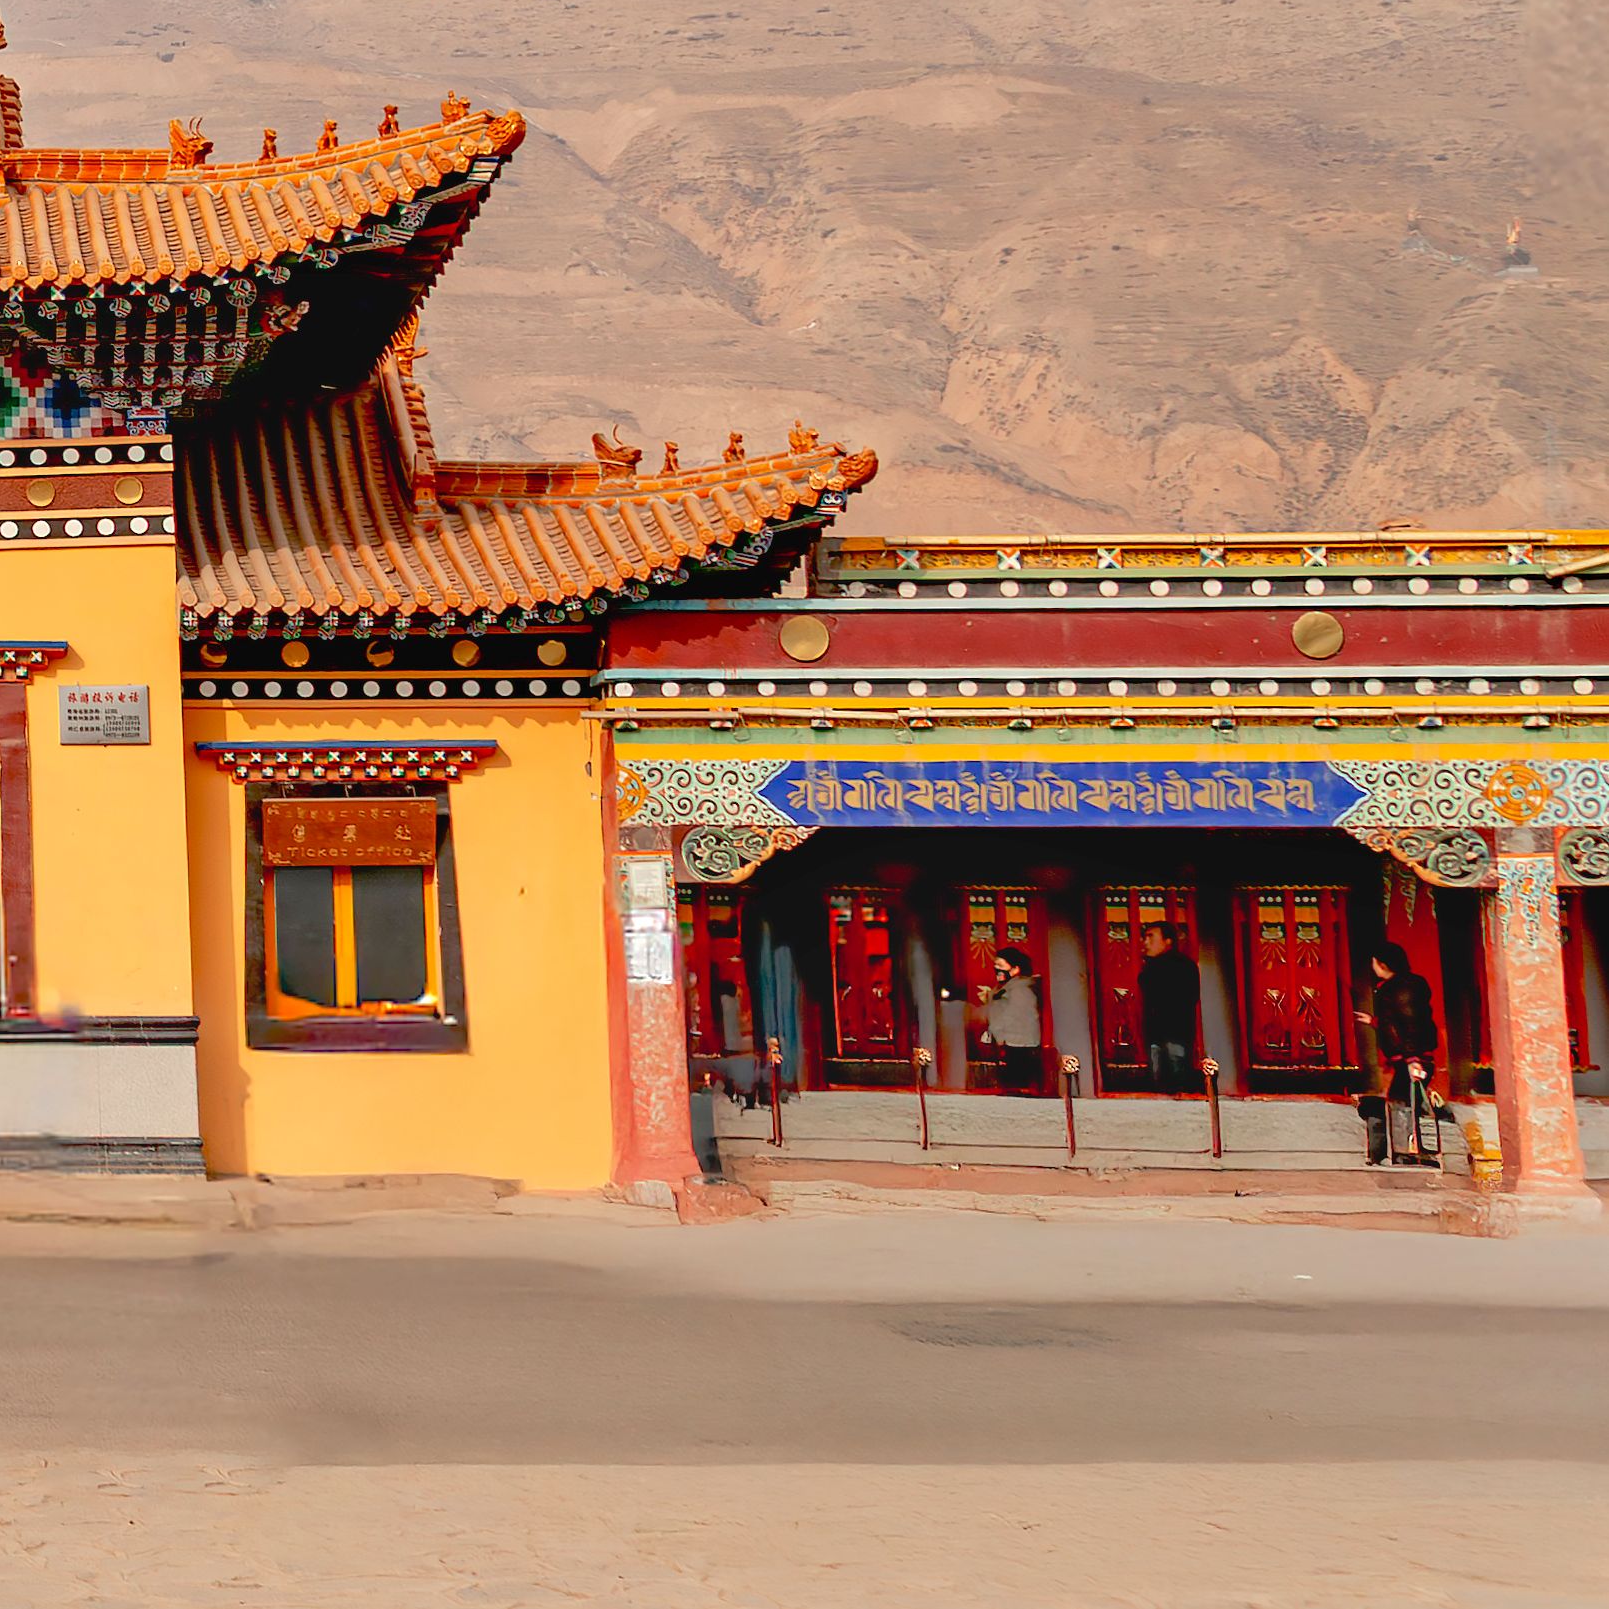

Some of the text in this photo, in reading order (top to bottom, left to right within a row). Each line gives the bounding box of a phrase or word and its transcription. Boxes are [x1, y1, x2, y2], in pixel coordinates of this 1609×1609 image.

[68, 691, 140, 704] 旅游投诉电话
[291, 823, 412, 843] 售票处
[286, 846, 348, 858] Ticket
